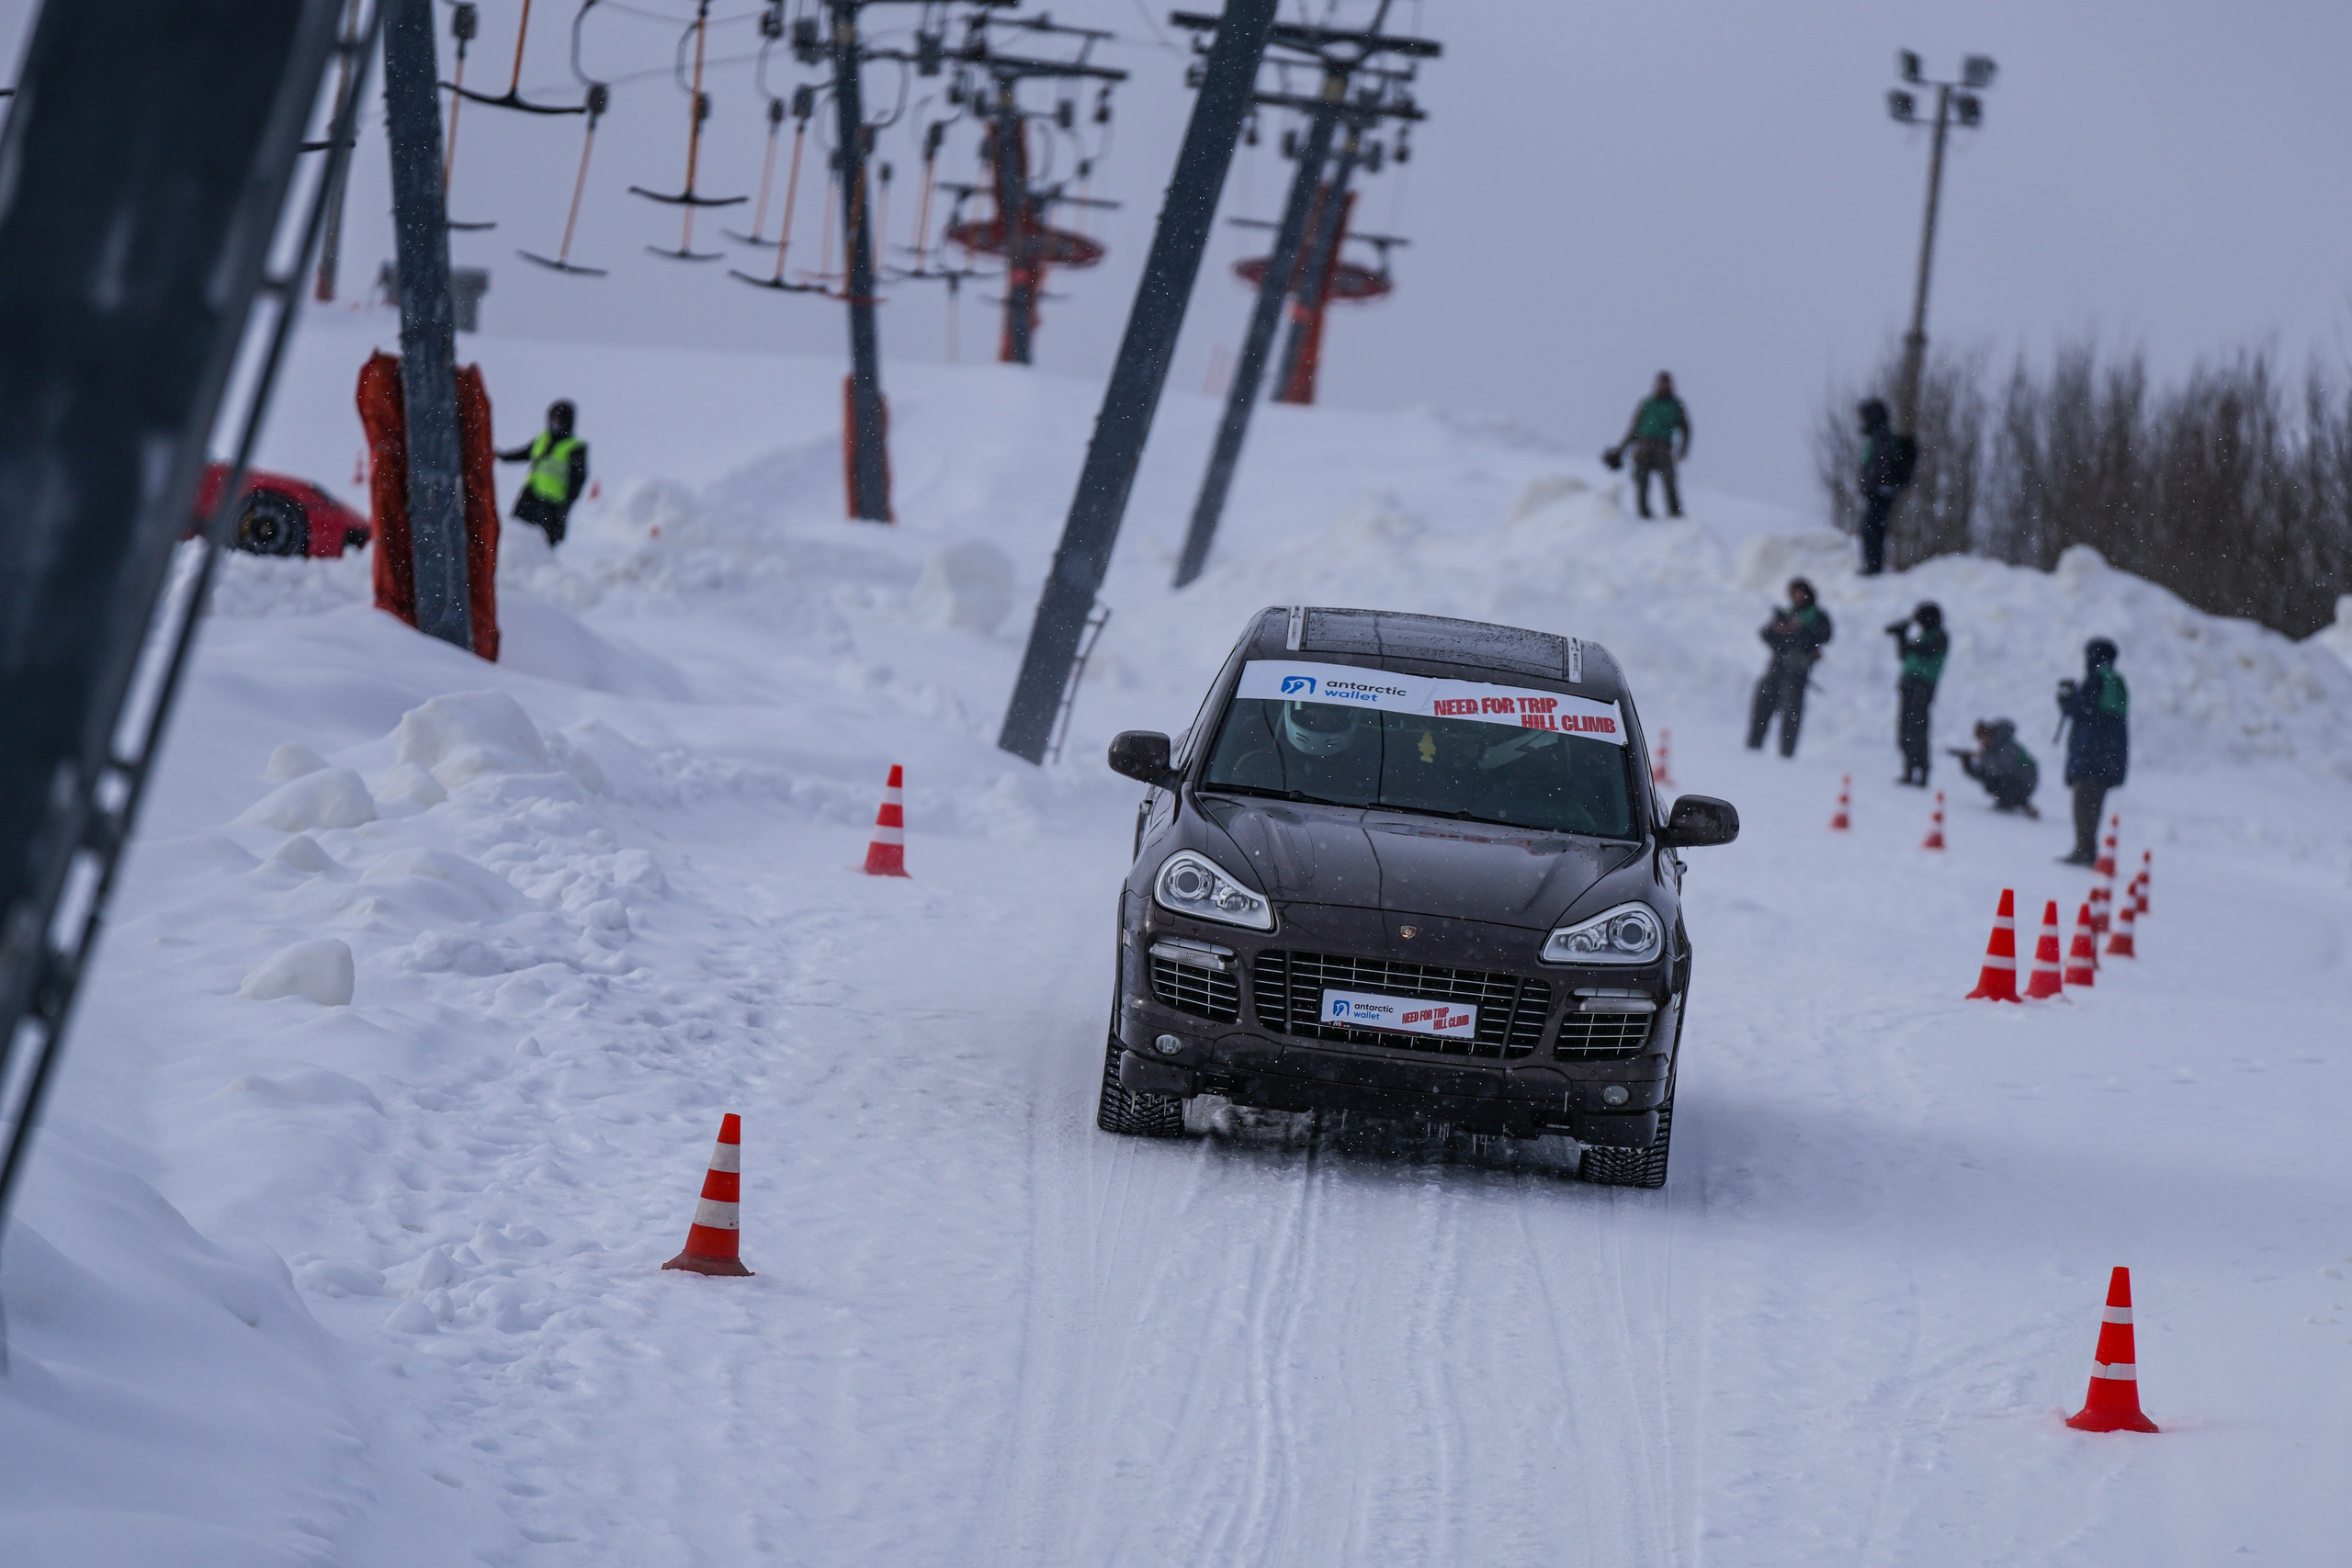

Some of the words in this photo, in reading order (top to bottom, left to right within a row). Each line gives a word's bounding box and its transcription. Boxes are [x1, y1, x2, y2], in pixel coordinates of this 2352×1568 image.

[1324, 689, 1378, 702] wallet
[1327, 681, 1407, 696] antarctic
[1433, 698, 1479, 716] NEED
[1481, 697, 1516, 714] FOR
[1516, 697, 1558, 713] TRIP
[1521, 715, 1559, 731] HILL
[1562, 715, 1616, 733] CLIMB
[1353, 1011, 1380, 1020] wallet
[1354, 1003, 1394, 1013] antarctic
[1402, 1011, 1419, 1024] NEED
[1419, 1010, 1433, 1021] FOR
[1433, 1007, 1450, 1019] TRIP
[1433, 1019, 1447, 1031] HILL
[1448, 1015, 1470, 1028] CLIMB
